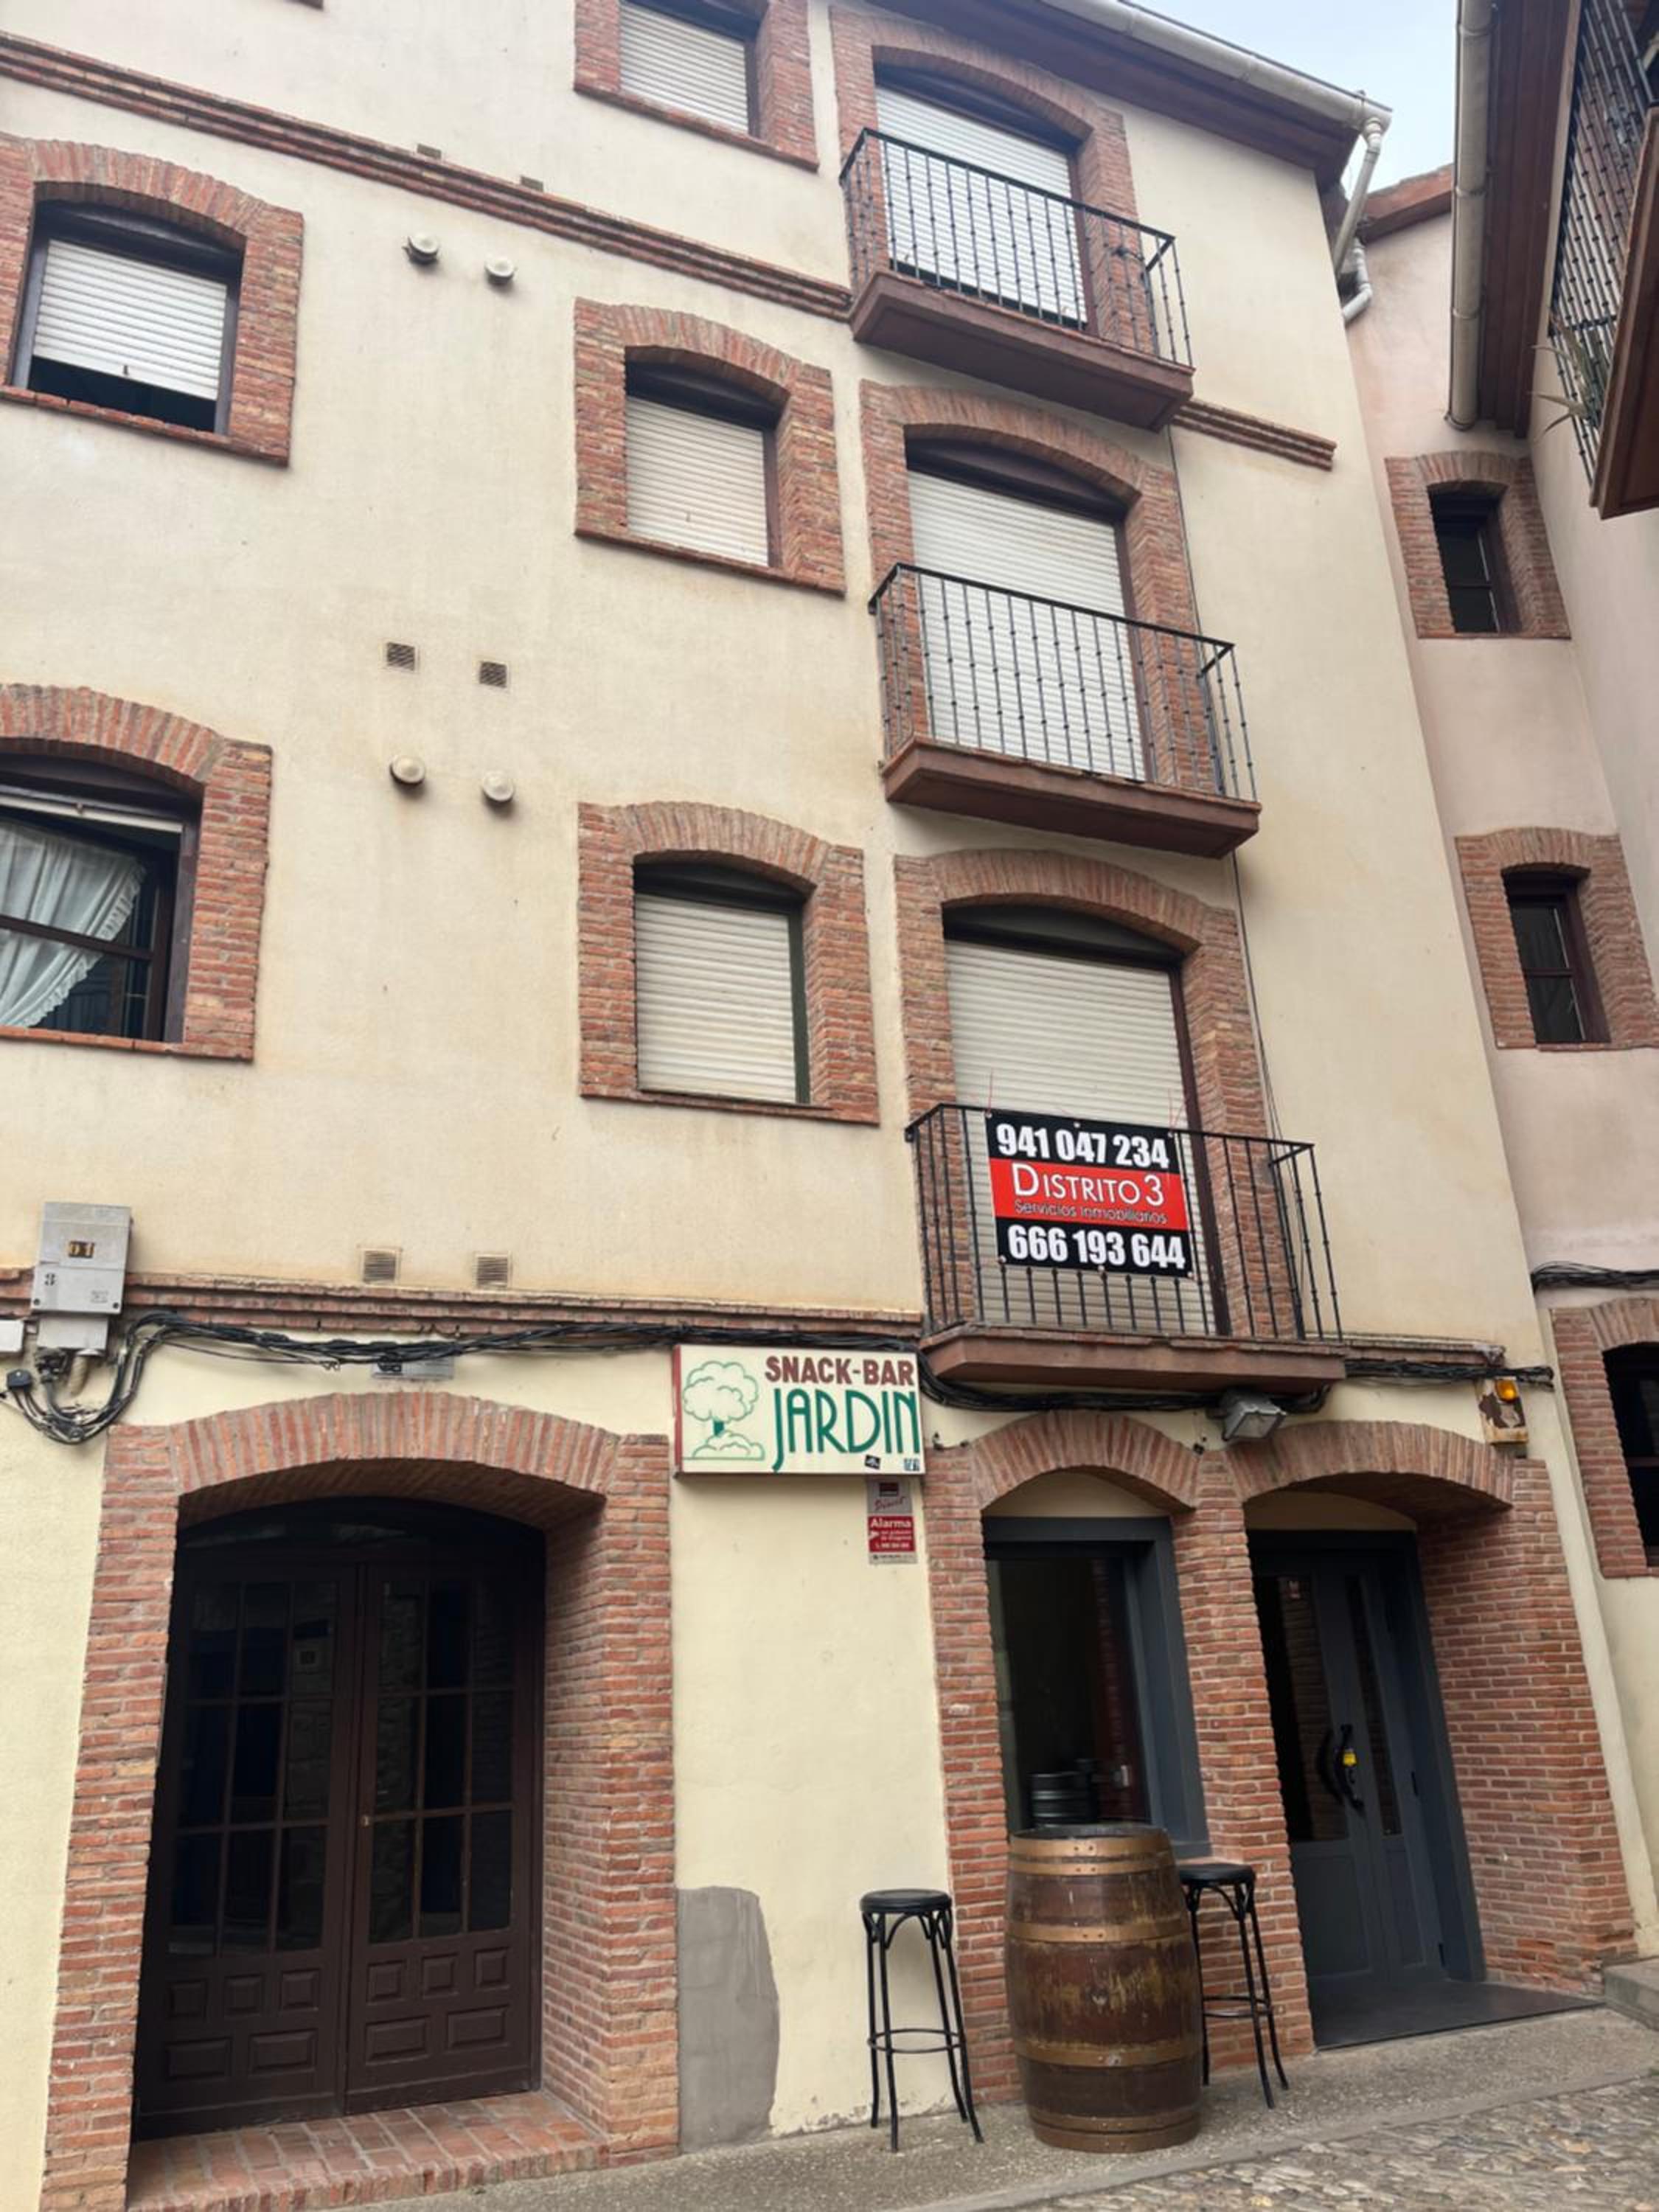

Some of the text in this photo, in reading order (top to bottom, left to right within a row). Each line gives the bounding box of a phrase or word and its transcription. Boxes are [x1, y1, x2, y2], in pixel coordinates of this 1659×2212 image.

[996, 1123, 1169, 1169] 941 047 234
[1144, 1175, 1164, 1206] 3
[1014, 1199, 1077, 1217] Servicios
[1008, 1225, 1186, 1269] 666 193 644
[765, 1355, 914, 1385] SNACK-BAR
[771, 1388, 920, 1472] JARDIN
[871, 1517, 912, 1528] Alarma
